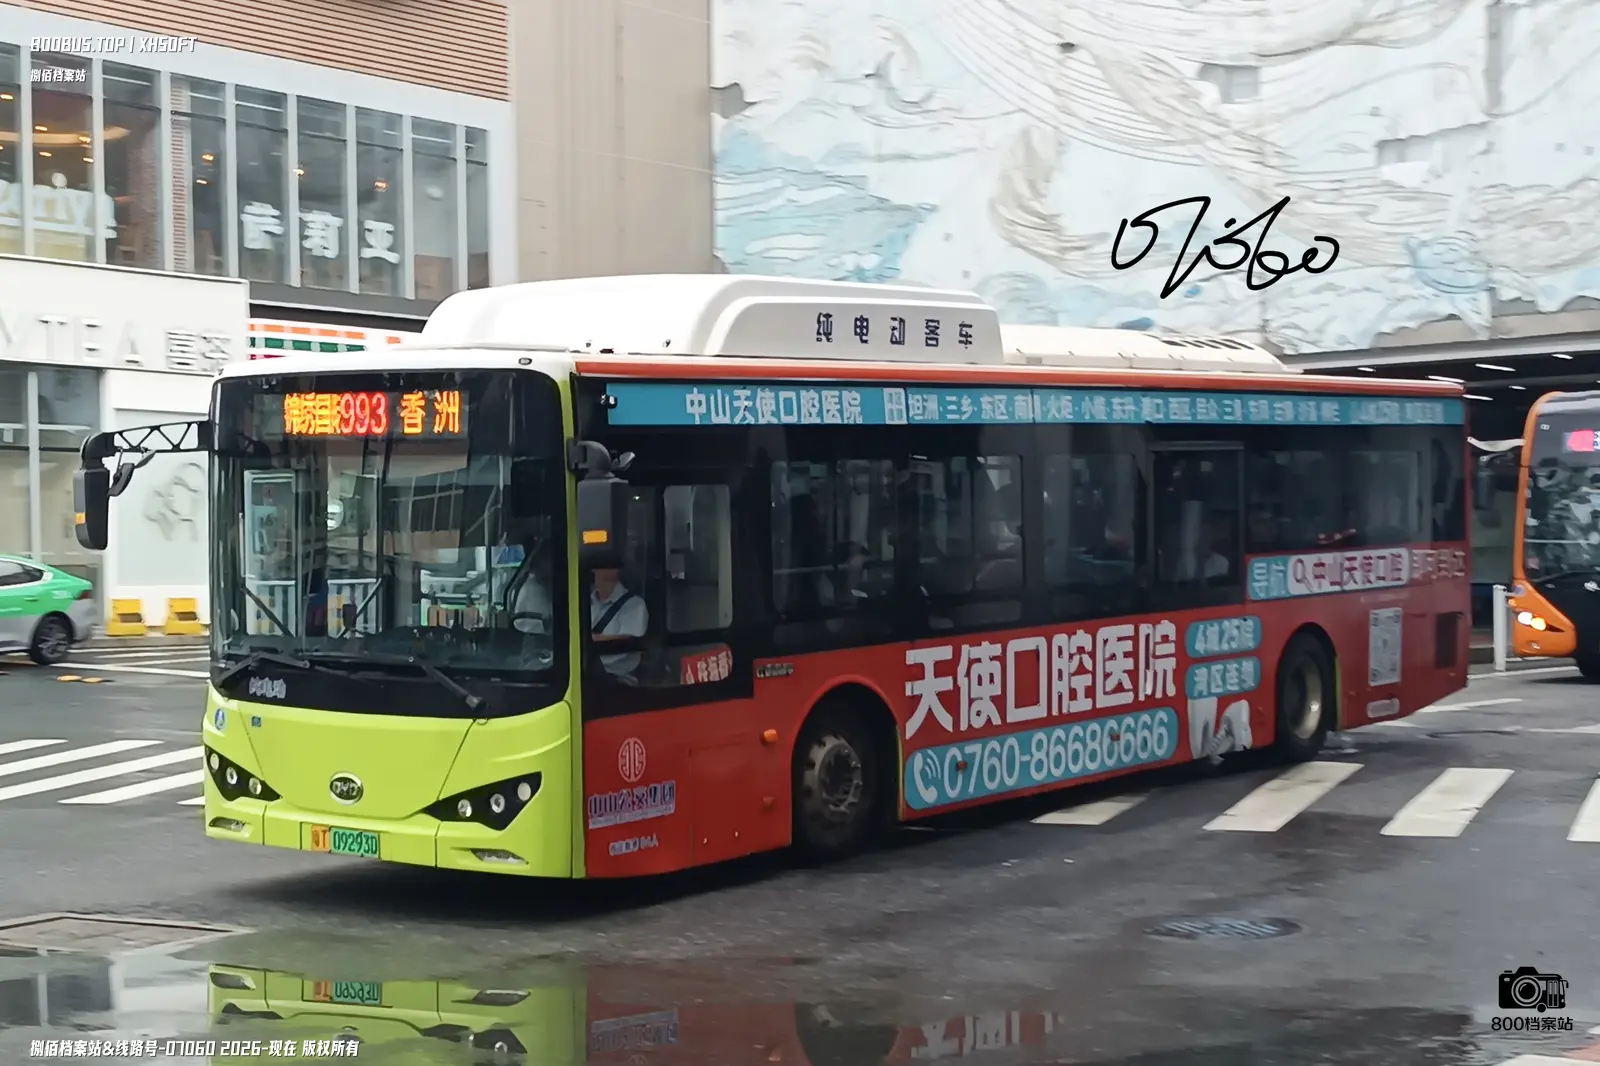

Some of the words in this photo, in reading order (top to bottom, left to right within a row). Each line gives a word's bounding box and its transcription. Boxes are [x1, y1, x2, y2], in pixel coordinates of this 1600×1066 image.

[816, 302, 973, 350] 纯电动客车
[341, 392, 388, 434] 993
[400, 390, 459, 434] 香洲
[685, 388, 863, 424] 中山天使口腔医院
[905, 620, 1177, 740] 天使口腔医院
[943, 710, 1169, 799] 0760-86686666
